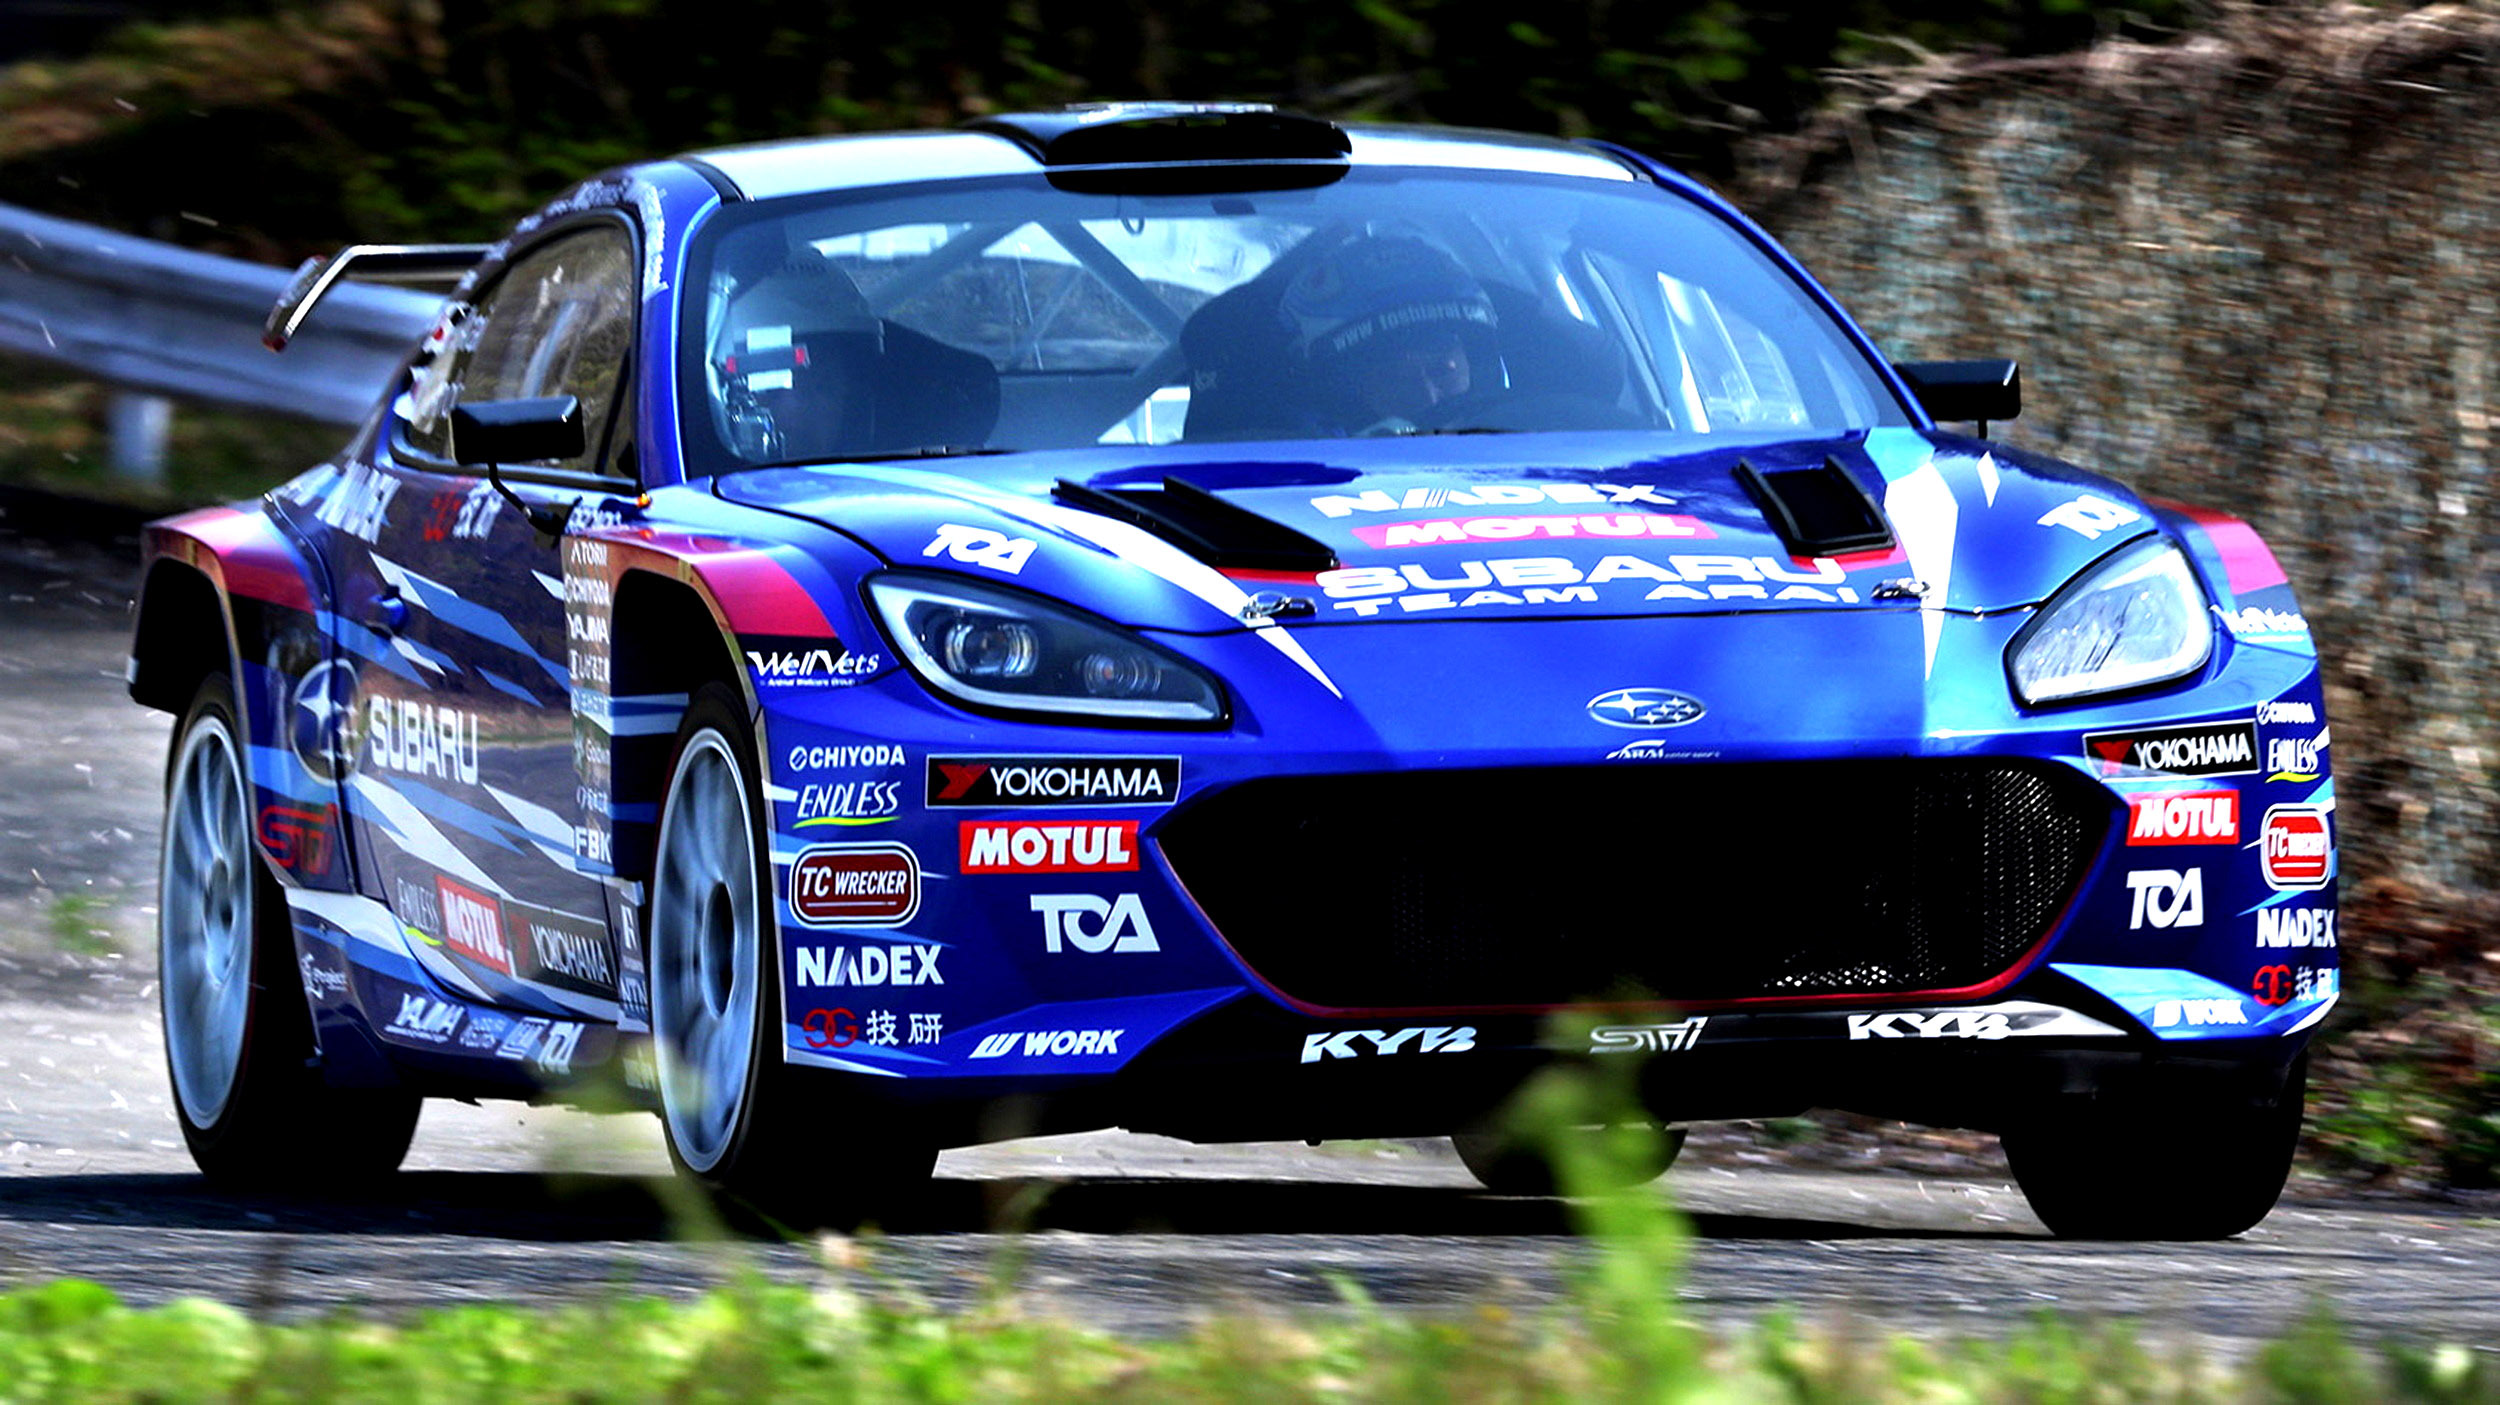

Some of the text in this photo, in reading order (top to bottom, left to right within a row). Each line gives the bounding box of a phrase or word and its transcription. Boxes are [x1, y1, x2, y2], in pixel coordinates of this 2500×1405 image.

[1311, 484, 1677, 518] NADEX
[1386, 515, 1695, 546] MOTUL
[1315, 555, 1847, 598] SUBARU
[1333, 584, 1860, 616] TEAM ARAI
[746, 649, 880, 676] WellVets
[369, 694, 479, 785] SUBARU
[812, 745, 906, 768] CHIYODA
[2134, 733, 2253, 770] YOKOHAMA
[797, 781, 901, 818] ENDLESS
[989, 767, 1163, 796] YOKOHAMA
[2133, 797, 2236, 838] MOTUL
[575, 826, 613, 864] FBK
[968, 826, 1131, 866] MOTUL
[801, 865, 907, 897] TC WRECKER
[2126, 867, 2204, 930] TOA
[440, 887, 507, 964] MOTUL
[528, 922, 613, 985] YOKOHAMA
[1030, 893, 1161, 954] TOA
[2256, 907, 2336, 948] NADEX
[796, 945, 945, 987] NADEX
[866, 1009, 944, 1046] 技研
[1023, 1029, 1125, 1057] WORK
[1847, 1012, 2011, 1040] KYB
[1300, 1026, 1478, 1064] KYB
